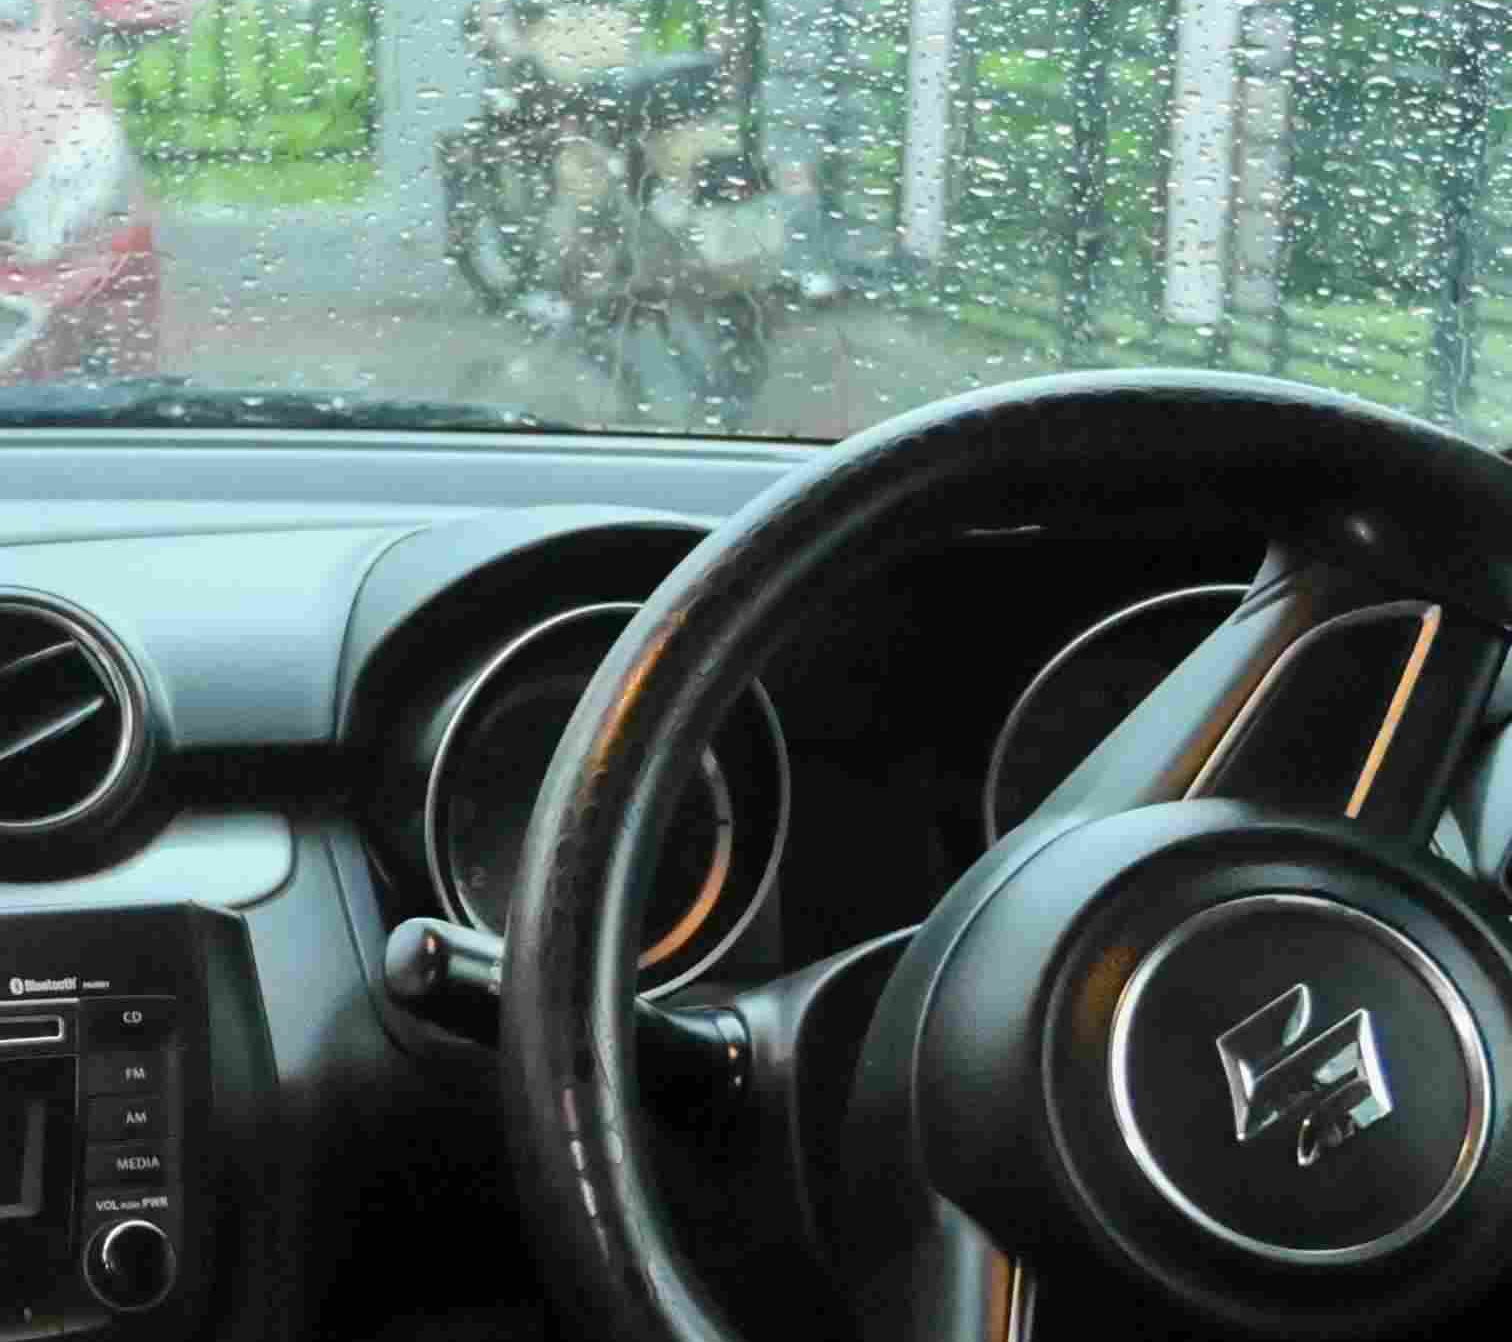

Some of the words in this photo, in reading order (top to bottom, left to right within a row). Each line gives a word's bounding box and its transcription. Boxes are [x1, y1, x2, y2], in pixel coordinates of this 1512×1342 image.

[122, 1010, 143, 1025] CD
[124, 1066, 146, 1080] FM
[125, 1109, 147, 1124] AM
[116, 1155, 160, 1171] MEDIA
[95, 1199, 120, 1212] VOL
